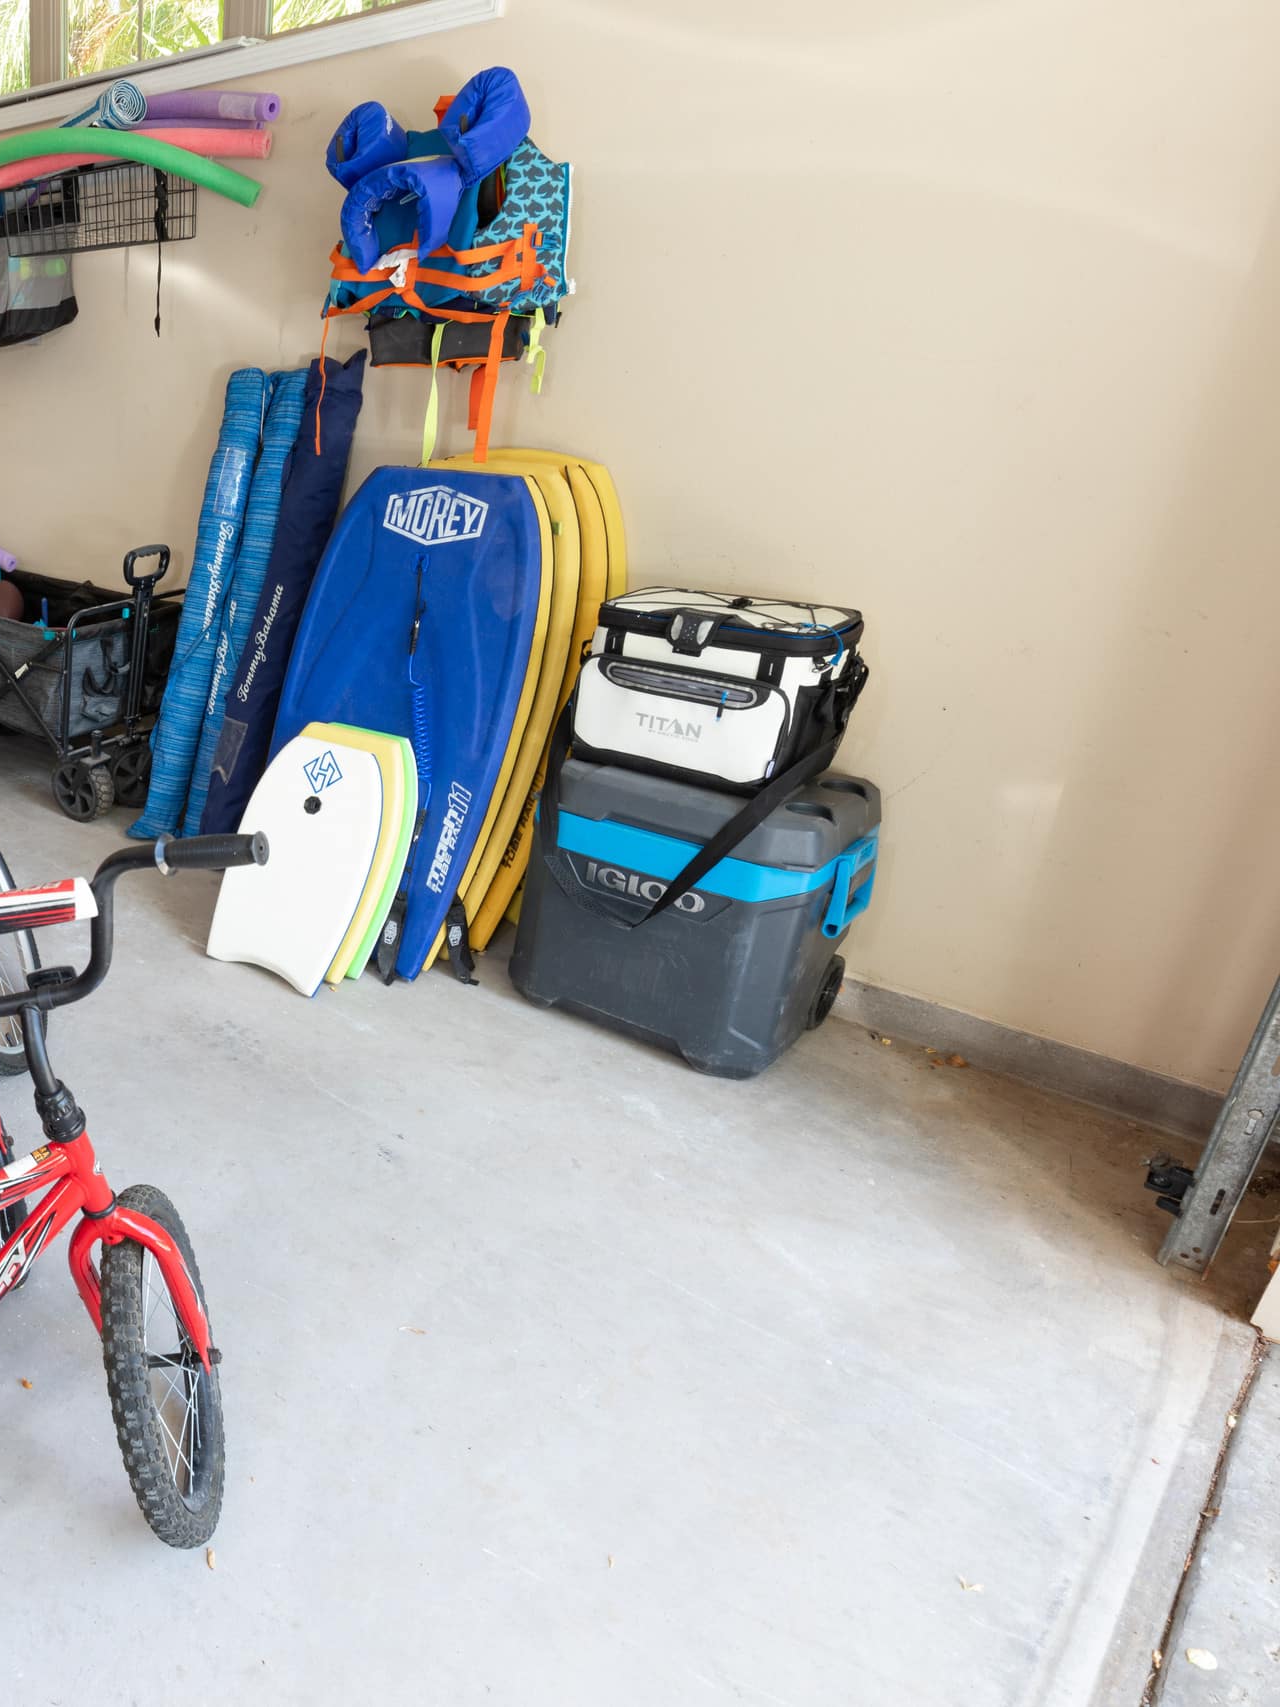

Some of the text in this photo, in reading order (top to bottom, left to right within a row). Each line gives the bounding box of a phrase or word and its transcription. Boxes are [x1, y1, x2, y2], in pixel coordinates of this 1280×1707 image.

[390, 491, 481, 540] MOREY
[635, 712, 702, 738] TITAN
[586, 861, 705, 913] IGLOO
